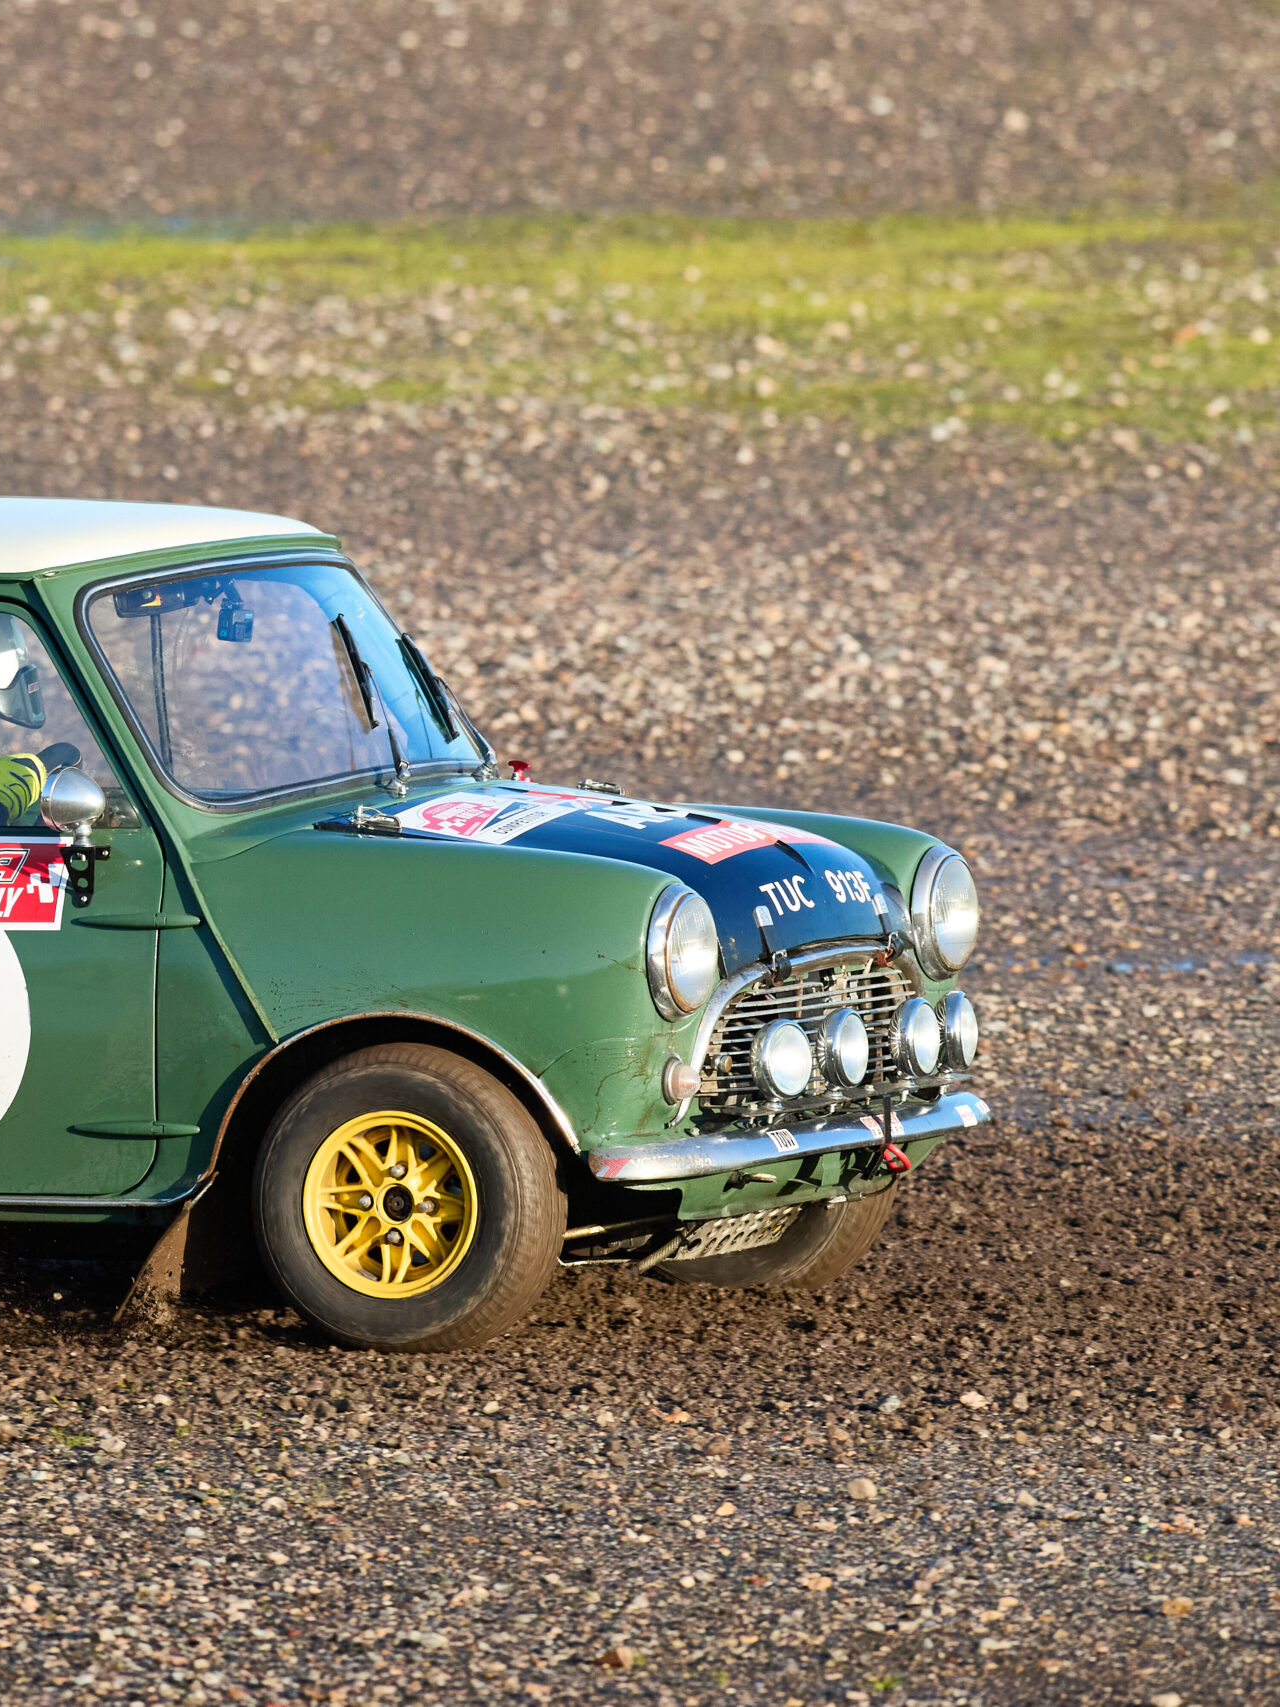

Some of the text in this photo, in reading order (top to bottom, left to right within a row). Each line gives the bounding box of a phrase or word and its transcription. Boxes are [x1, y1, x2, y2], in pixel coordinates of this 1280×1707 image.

[758, 869, 871, 916] TUC 913F
[771, 1130, 797, 1148] TOW
